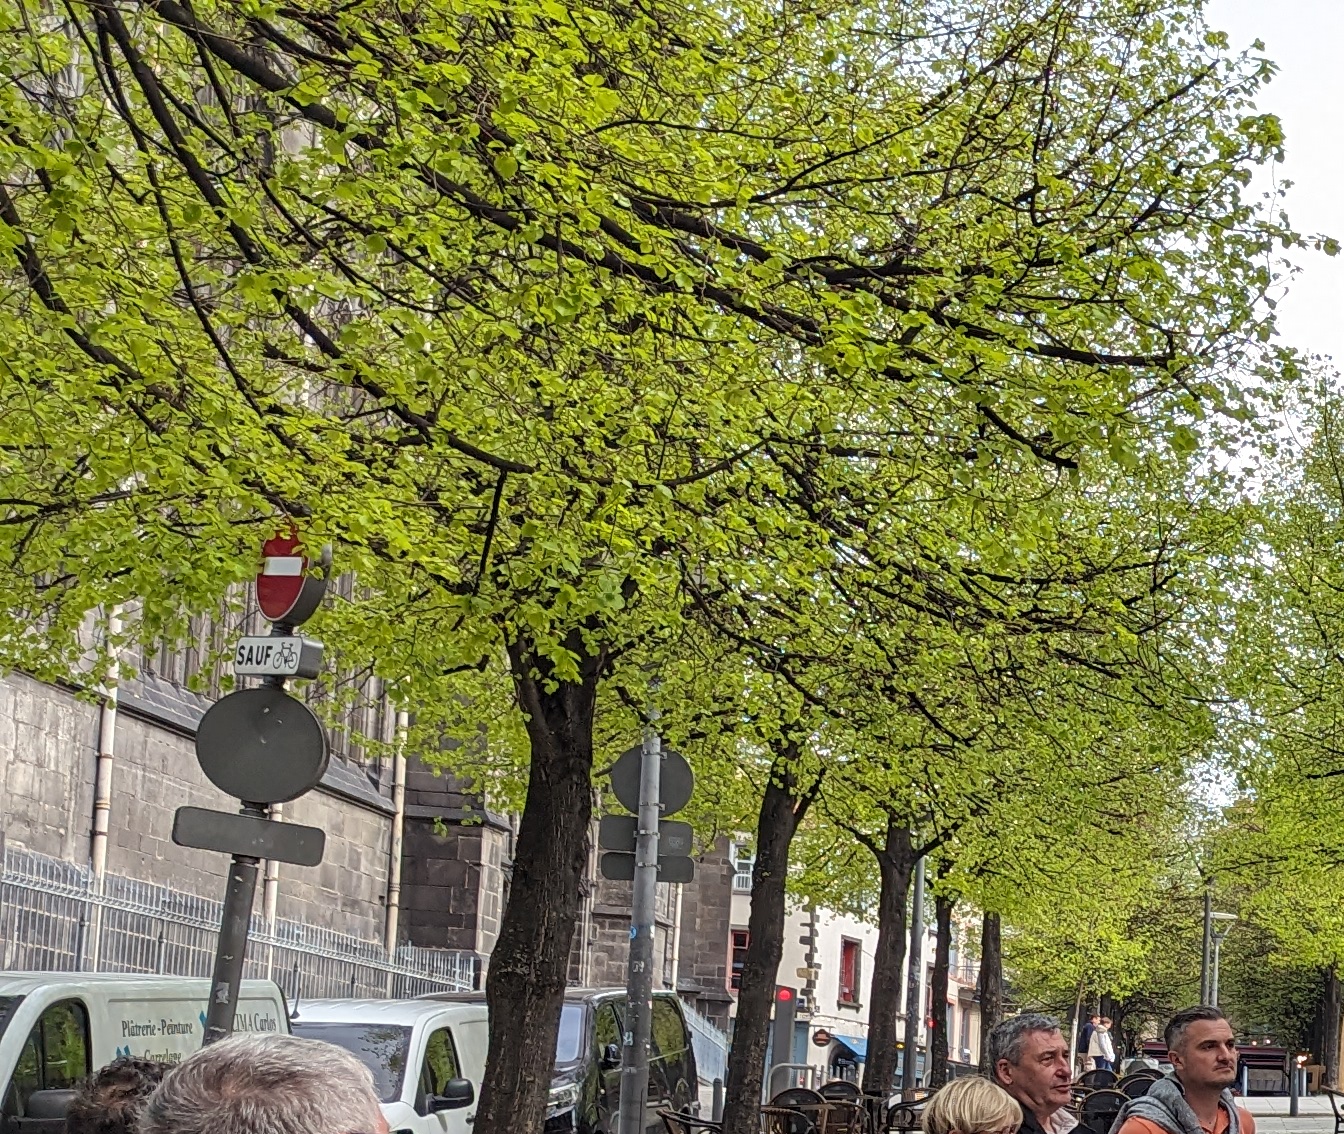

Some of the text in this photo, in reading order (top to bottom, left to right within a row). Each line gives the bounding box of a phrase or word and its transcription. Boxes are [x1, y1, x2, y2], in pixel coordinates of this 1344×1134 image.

[237, 645, 273, 666] SAUF
[122, 1020, 156, 1037] Plâtrerie
[161, 1018, 193, 1036] Peinture
[254, 1012, 277, 1032] Carlos
